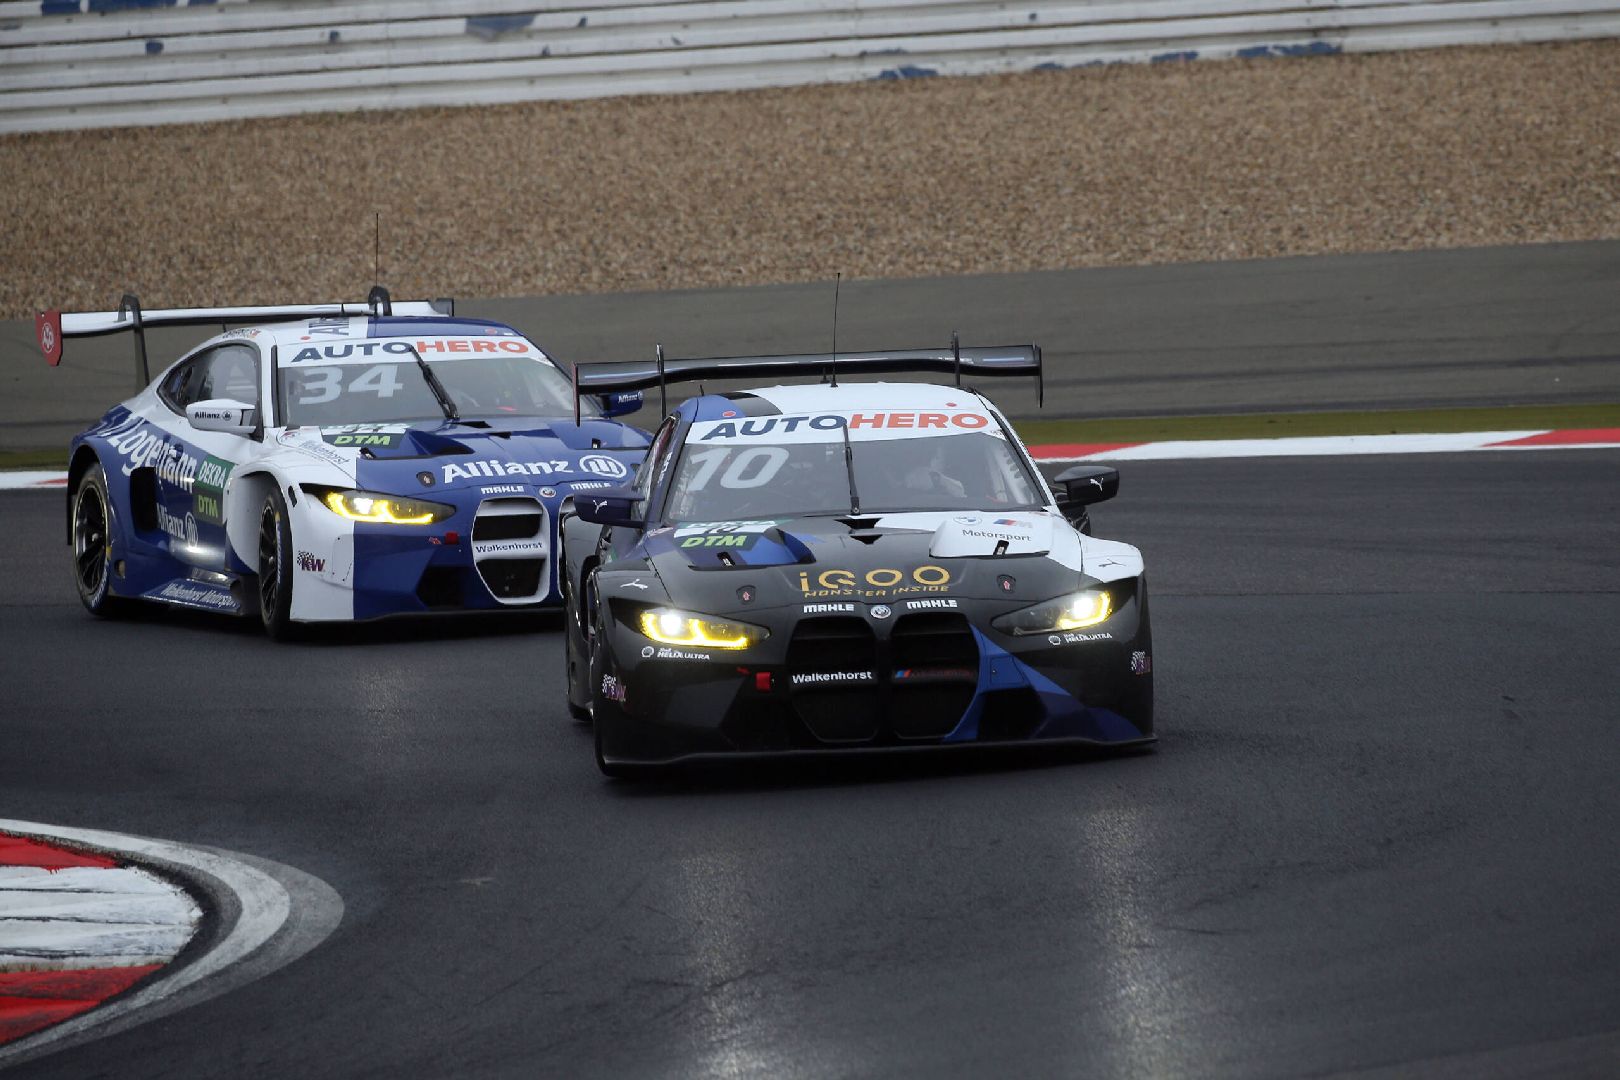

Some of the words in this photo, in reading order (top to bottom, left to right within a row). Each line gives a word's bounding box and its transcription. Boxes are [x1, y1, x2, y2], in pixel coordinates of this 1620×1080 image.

[291, 340, 529, 363] AUTOHERO
[297, 364, 403, 404] 34
[194, 411, 220, 419] Allianz
[700, 412, 989, 441] AUTOHERO
[334, 435, 391, 446] DTM
[198, 460, 227, 489] DEKRA
[441, 460, 574, 484] Allianz
[686, 446, 790, 493] 10
[480, 485, 525, 494] MAHLE
[198, 494, 218, 518] DTM
[681, 535, 748, 548] DTM
[962, 529, 1032, 541] Motorsport
[476, 541, 543, 554] Walkenhorst
[804, 588, 887, 598] MONSTER
[892, 584, 950, 596] INSIDE
[803, 603, 855, 614] MAHLE
[906, 599, 958, 610] MAHLE
[792, 670, 873, 684] Walkenhorst
